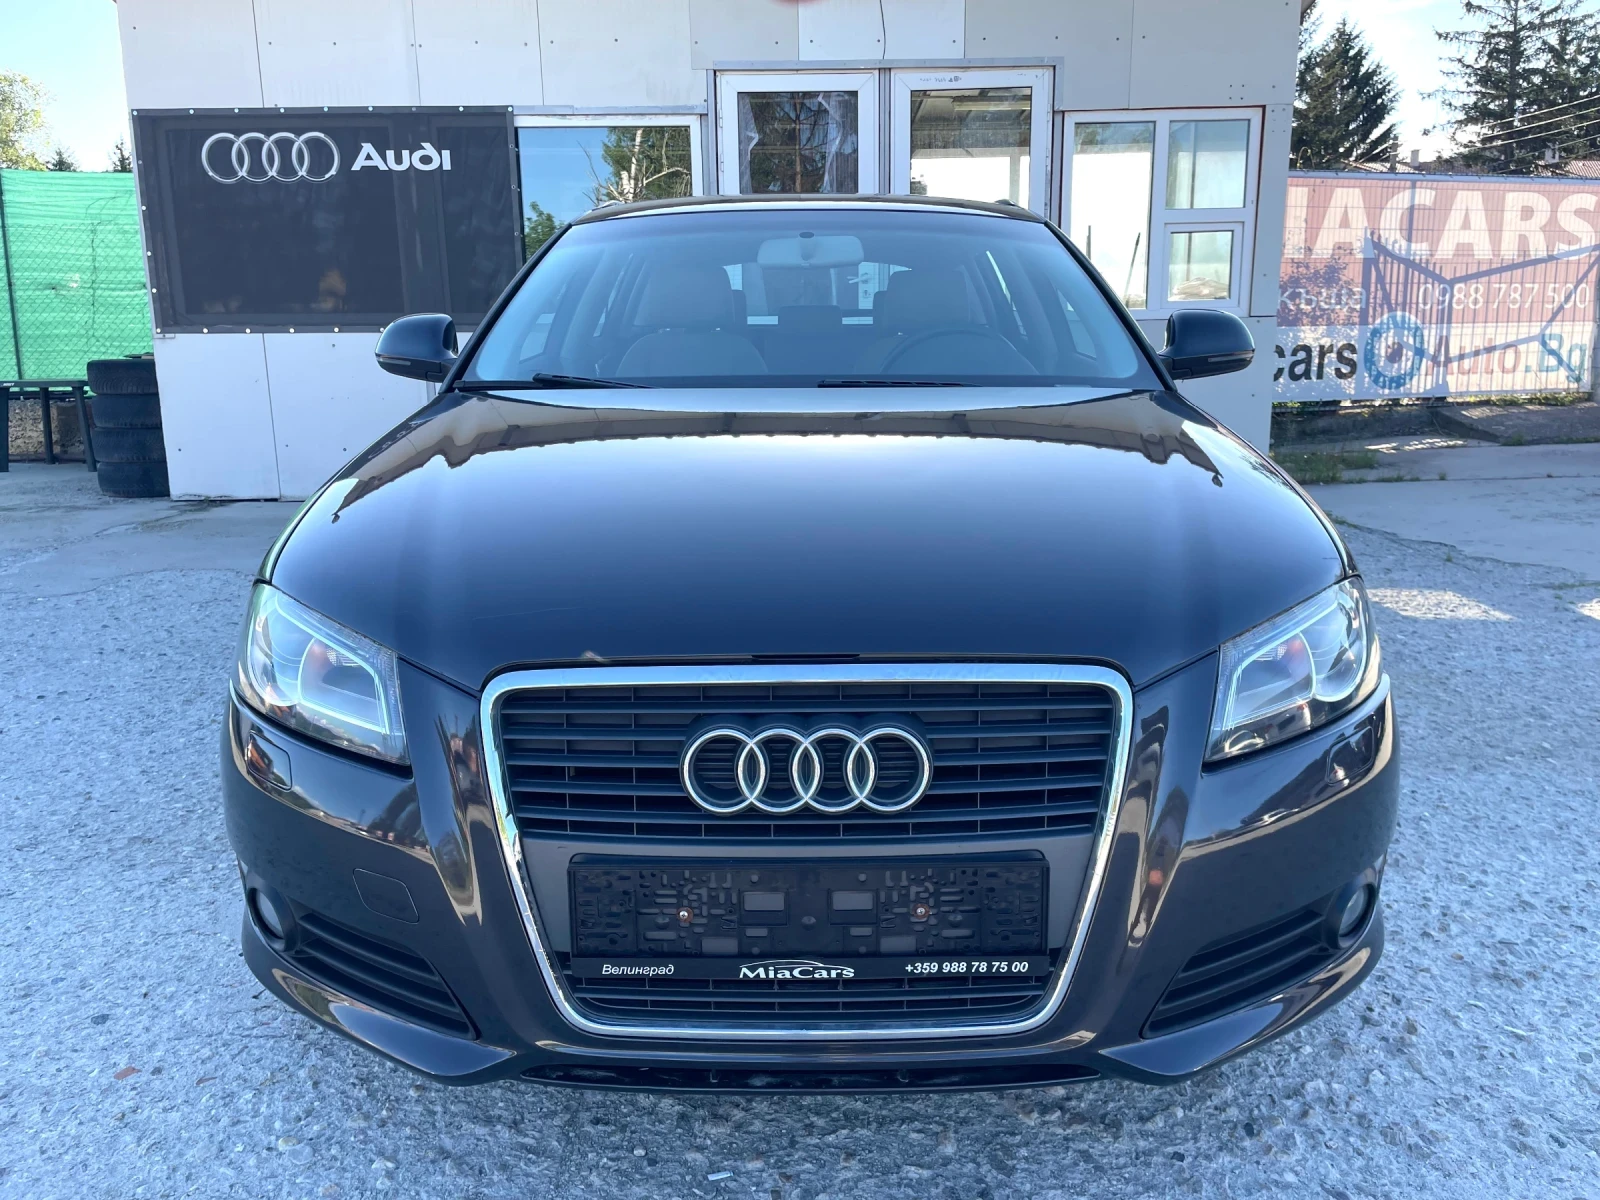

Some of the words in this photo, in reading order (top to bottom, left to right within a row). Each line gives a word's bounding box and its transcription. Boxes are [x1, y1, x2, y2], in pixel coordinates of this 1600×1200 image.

[351, 142, 452, 171] Audi
[1418, 283, 1484, 310] 0988
[1491, 283, 1539, 309] 787
[1544, 282, 1590, 309] 500
[602, 964, 675, 977] Велинград
[739, 966, 855, 979] MiaCars
[905, 962, 939, 974] +359
[942, 961, 967, 973] 988
[971, 961, 988, 973] 78
[991, 961, 1009, 973] 75
[1011, 961, 1029, 973] 00
